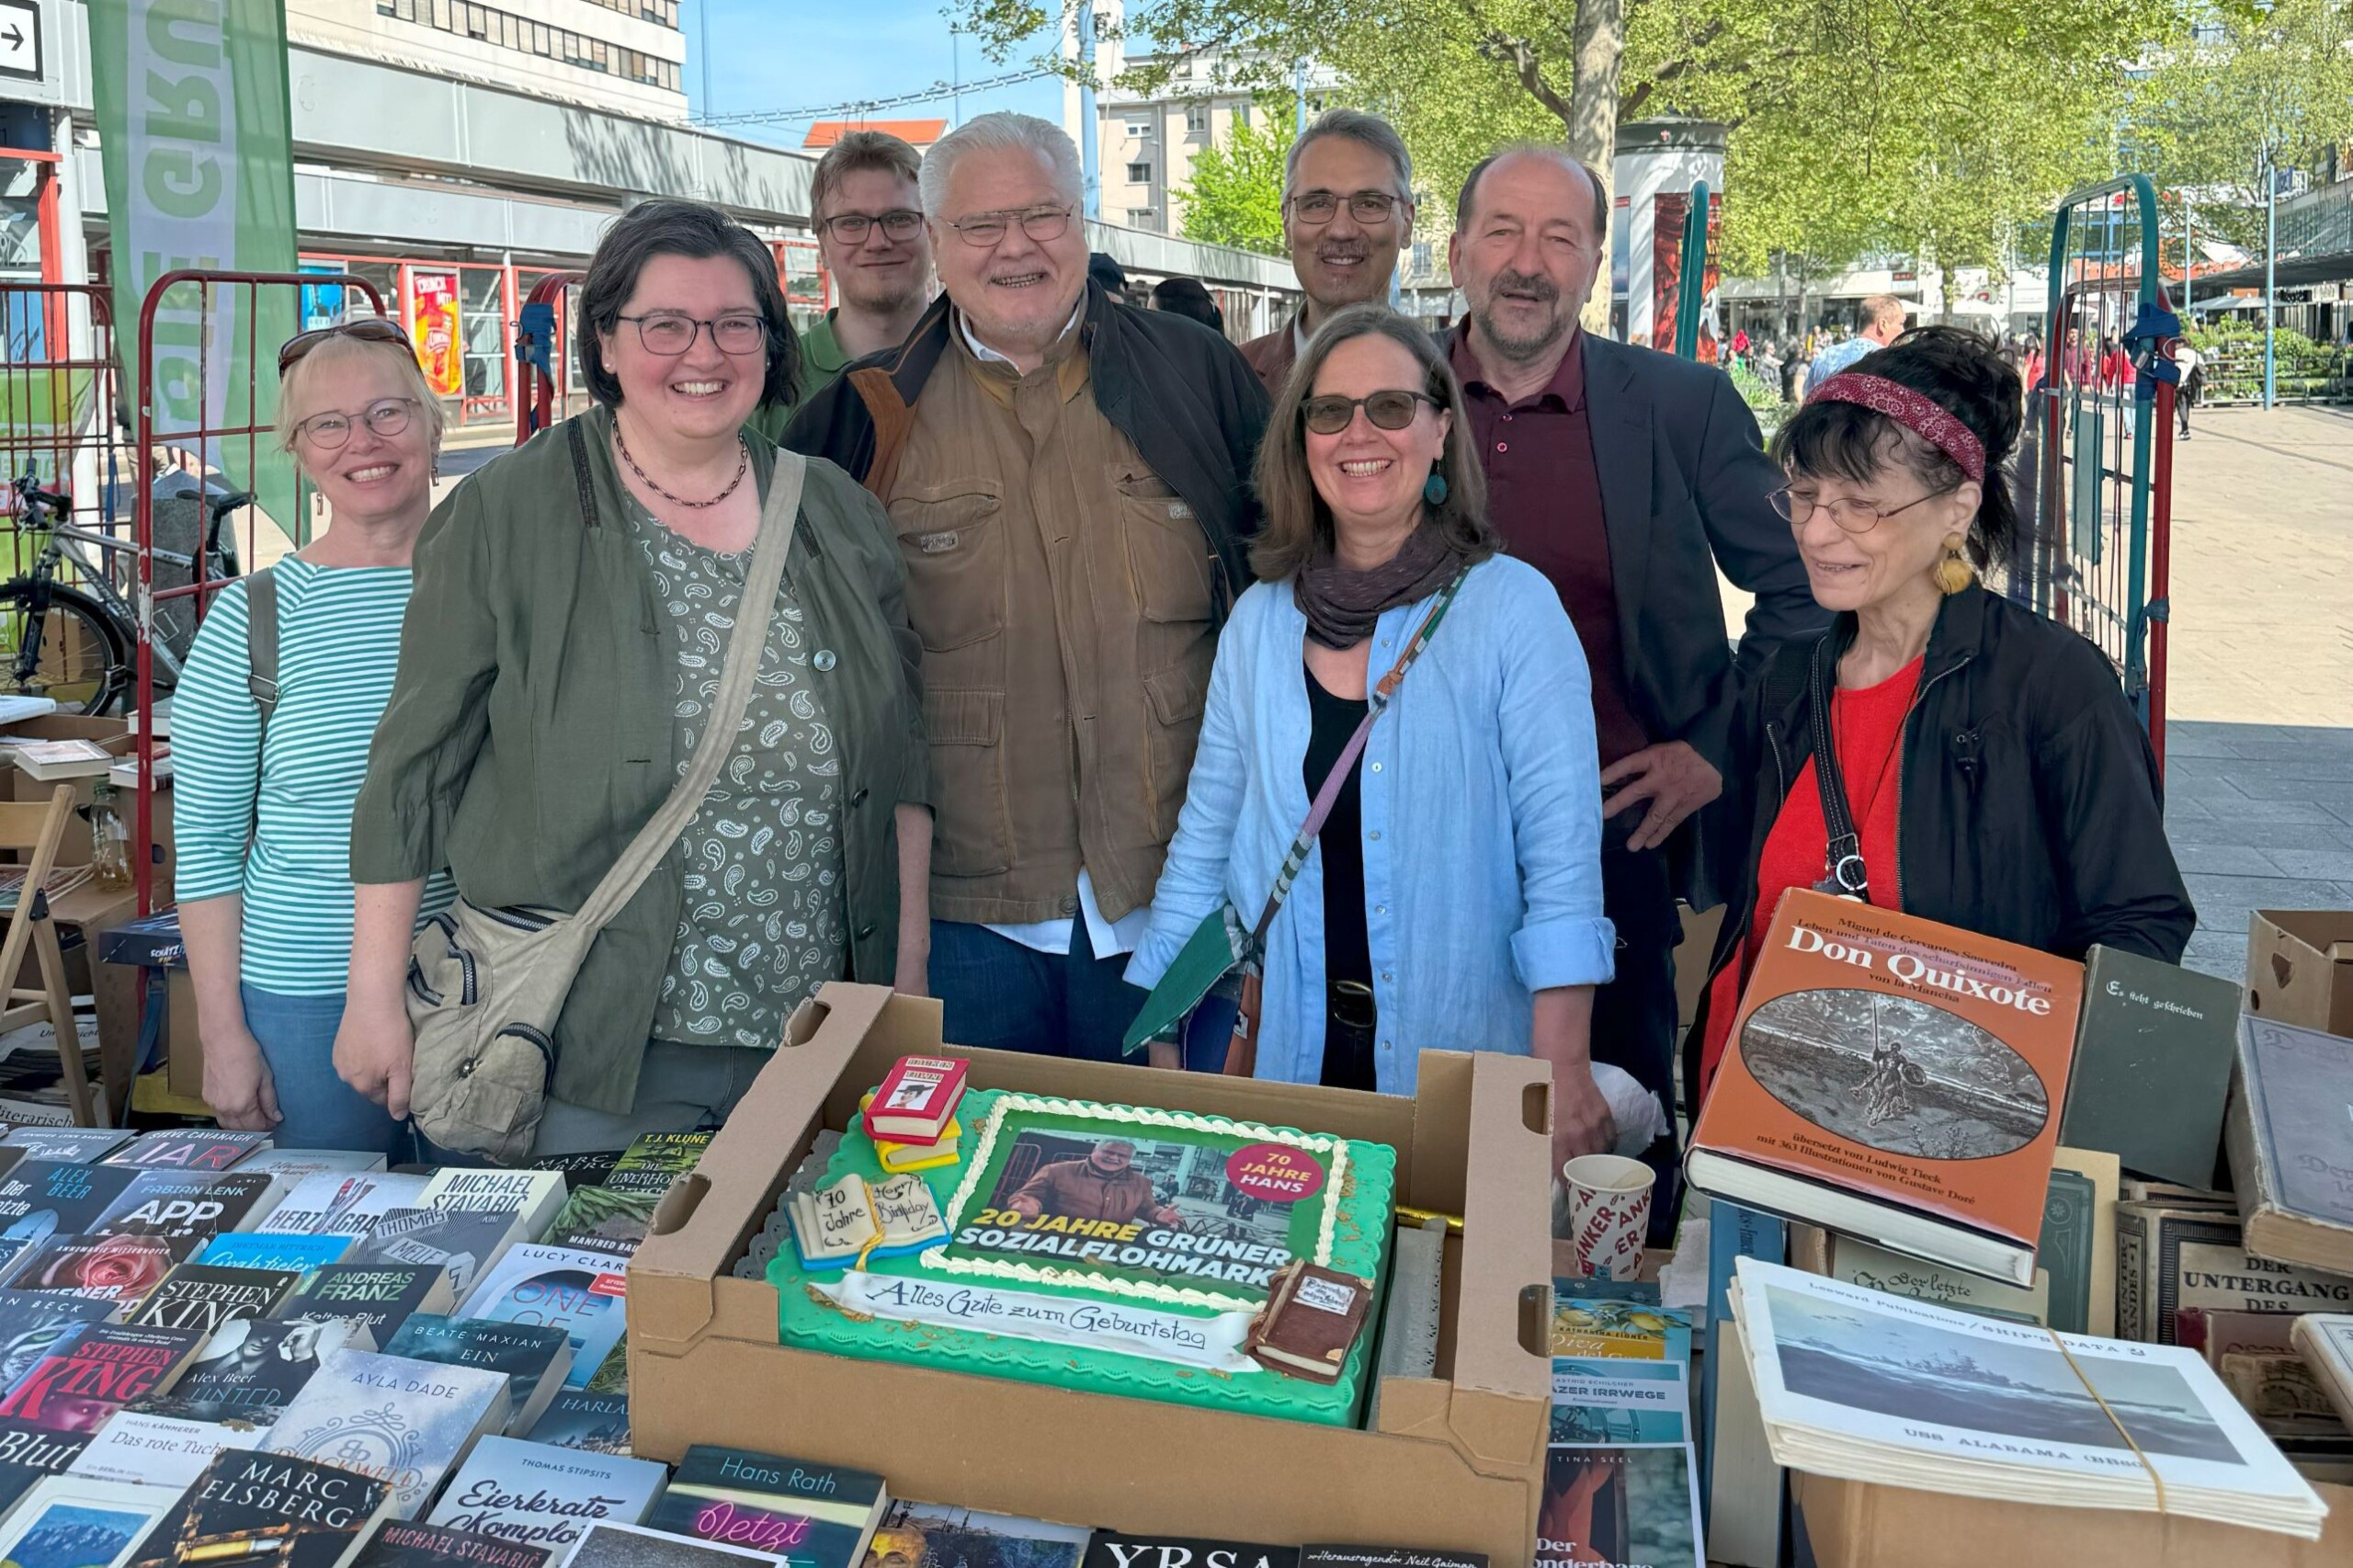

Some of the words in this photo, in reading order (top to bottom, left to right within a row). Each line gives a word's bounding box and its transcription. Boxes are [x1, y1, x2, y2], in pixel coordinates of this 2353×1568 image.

[1797, 918, 1833, 934] Leben
[1836, 930, 1859, 941] und
[1865, 937, 1897, 949] Taten
[1900, 945, 1920, 956] des
[1838, 917, 1880, 936] Miguel
[1882, 930, 1898, 938] de
[1900, 935, 1959, 956] Cervantes
[1961, 951, 2018, 972] Saavedra
[1784, 925, 1873, 970] Don
[1887, 953, 2051, 1016] Quixote
[1869, 972, 1891, 984] von
[1894, 978, 1906, 988] la
[1908, 983, 1960, 1004] Mancha
[2106, 980, 2124, 996] Es
[149, 1131, 187, 1140] STEVE
[188, 1132, 254, 1142] CAVANAGH
[666, 1134, 710, 1145] KLUNE
[102, 1142, 241, 1168] LIAR
[534, 1154, 609, 1166] MARC
[1266, 1153, 1291, 1165] 70
[1792, 1132, 1841, 1154] übersetzt
[1844, 1148, 1864, 1161] von
[1867, 1152, 1908, 1176] Ludwig
[1911, 1166, 1941, 1185] Tieck
[47, 1167, 93, 1184] ALEX
[1239, 1163, 1312, 1182] JAHRE
[1756, 1133, 1776, 1145] mit
[1800, 1143, 1873, 1175] Illustrationen
[1876, 1169, 1896, 1182] von
[1899, 1176, 1945, 1197] Gustave
[1948, 1189, 1976, 1205] Doré
[0, 1180, 32, 1196] Der
[47, 1183, 92, 1199] BEER
[141, 1185, 203, 1195] FABIAN
[204, 1186, 248, 1196] LENK
[443, 1174, 535, 1195] MICHAEL
[1240, 1175, 1303, 1193] HANS
[119, 1199, 224, 1226] APP
[822, 1208, 866, 1232] Jahre
[875, 1199, 929, 1223] Birthday
[378, 1210, 446, 1237] THOMAS
[568, 1235, 617, 1250] MANFRED
[972, 1208, 1022, 1227] 20
[1024, 1213, 1144, 1243] JAHRE
[1145, 1229, 1292, 1267] GRÜNER
[522, 1249, 570, 1262] LUCY
[577, 1256, 625, 1271] CLAR
[955, 1227, 1279, 1287] SOZIALFLOHMARK
[2245, 1257, 2292, 1274] DER
[327, 1272, 415, 1285] ANDREAS
[1930, 1273, 1972, 1297] letzte
[2184, 1271, 2349, 1301] UNTERGANG
[160, 1279, 280, 1305] STEPHEN
[314, 1284, 408, 1301] FRANZ
[514, 1282, 599, 1317] ONE
[31, 1300, 84, 1313] BECK
[865, 1280, 944, 1307] Alles
[946, 1289, 1003, 1318] Gute
[1008, 1305, 1065, 1324] zum
[1068, 1305, 1206, 1350] Geburtstag
[415, 1326, 467, 1339] BEATE
[476, 1333, 542, 1348] MAXIAN
[2063, 1339, 2120, 1353] DATA
[74, 1341, 180, 1367] STEPHEN
[460, 1349, 499, 1363] EIN
[0, 1356, 164, 1420] KING
[187, 1372, 219, 1384] Alex
[221, 1373, 256, 1384] Beer
[352, 1372, 397, 1390] AYLA
[405, 1381, 460, 1398] DADE
[1592, 1388, 1665, 1400] IRRWEGE
[126, 1419, 151, 1429] HANS
[152, 1422, 201, 1435] KÄMMERER
[0, 1430, 82, 1470] Blut
[110, 1431, 141, 1448] Das
[142, 1437, 179, 1451] rote
[183, 1439, 222, 1456] Tuch
[1904, 1427, 1945, 1442] USS
[1959, 1437, 2073, 1460] ALABAMA
[240, 1460, 349, 1500] MARC
[522, 1458, 564, 1472] THOMAS
[567, 1466, 611, 1480] STIPSITS
[720, 1456, 780, 1484] Hans
[788, 1468, 836, 1494] Rath
[199, 1479, 355, 1528] ELSBERG
[458, 1480, 626, 1518] Eierkratz
[698, 1501, 811, 1553] Jetzt
[382, 1527, 452, 1553] MICHAEL
[1537, 1538, 1577, 1552] Der
[1404, 1555, 1429, 1565] Neil
[1431, 1557, 1477, 1568] Gaiman
